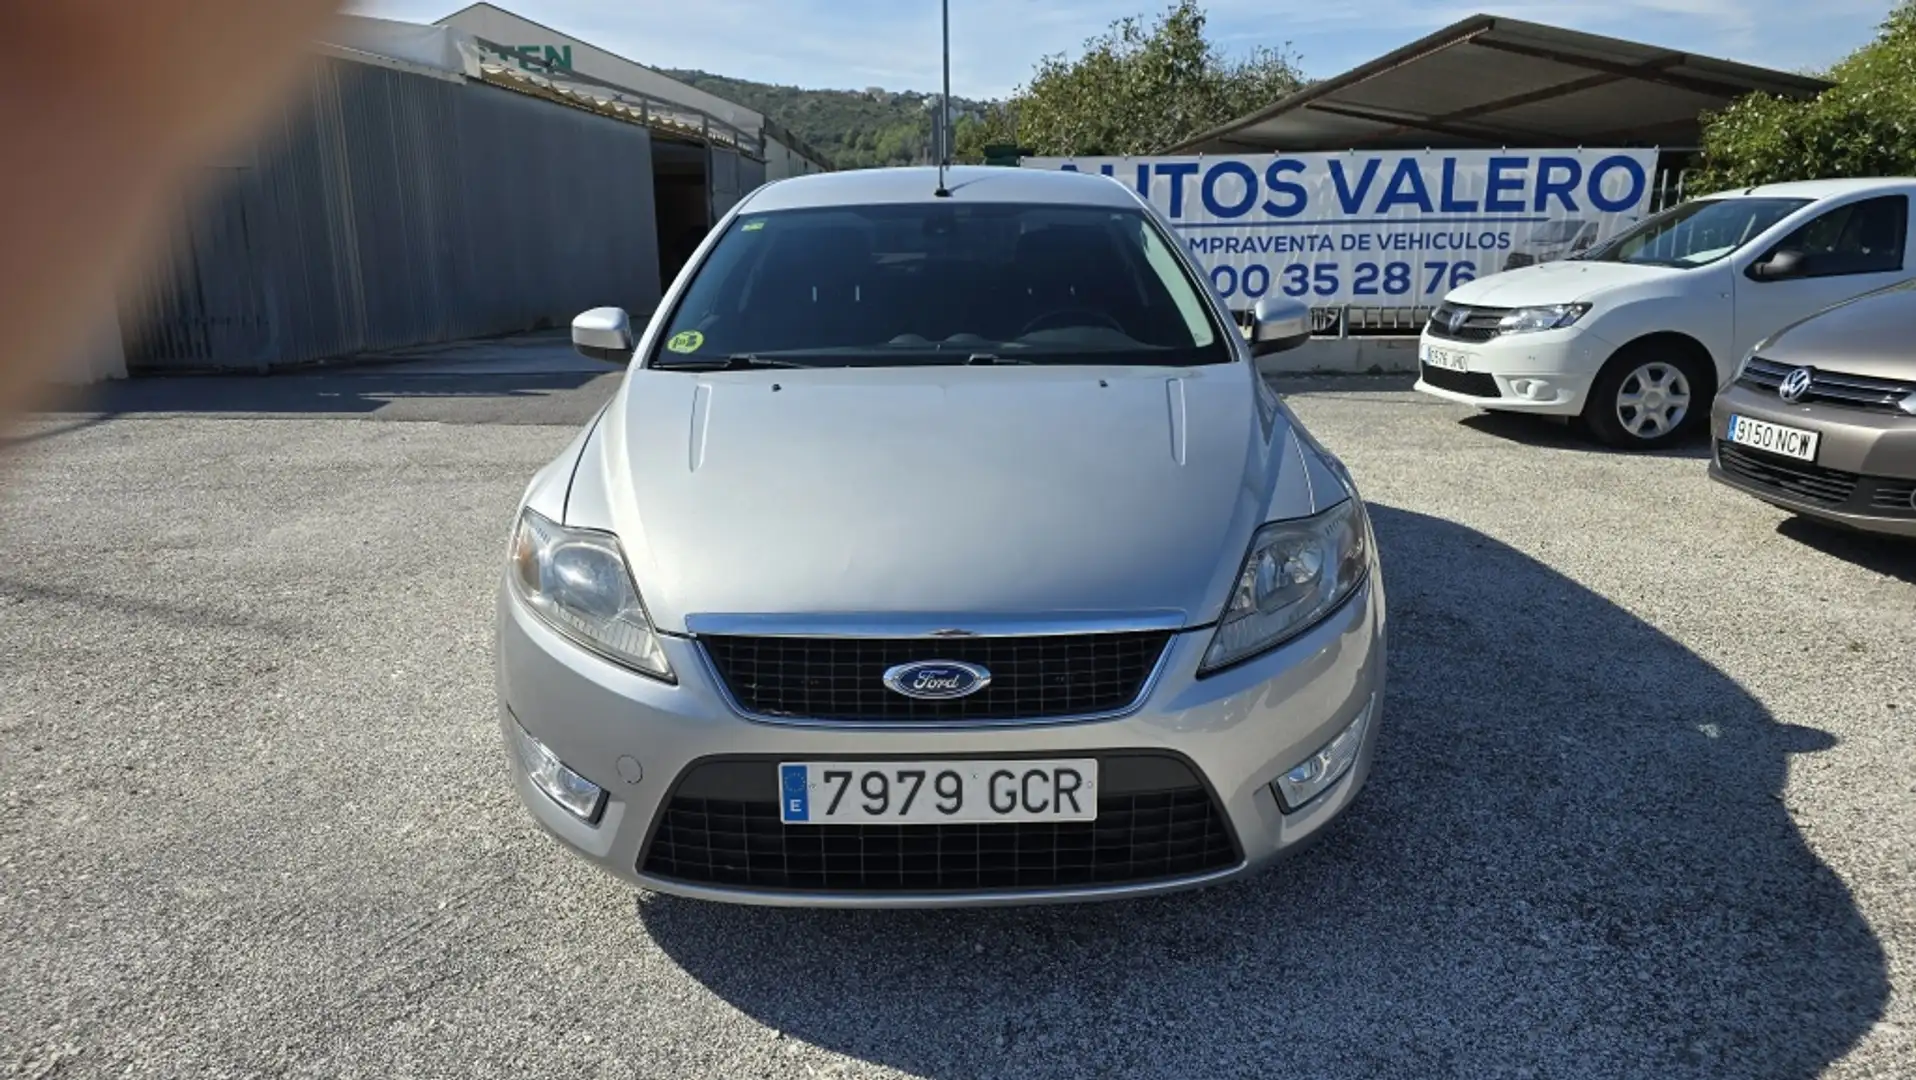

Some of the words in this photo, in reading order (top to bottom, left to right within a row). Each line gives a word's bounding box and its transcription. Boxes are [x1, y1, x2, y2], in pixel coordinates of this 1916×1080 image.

[1061, 159, 1308, 219] TOS
[1327, 155, 1646, 214] VALERO
[1189, 234, 1333, 254] MPRAVENTA
[1341, 233, 1371, 251] DE
[1377, 231, 1511, 250] VEHICULOS
[1210, 264, 1270, 299] 00
[1282, 263, 1340, 297] 35
[1353, 261, 1411, 295] 28
[1424, 260, 1476, 294] 76
[1736, 420, 1774, 448] 9150
[1775, 428, 1811, 457] NCW
[913, 669, 961, 690] Ford
[790, 799, 803, 812] E
[823, 769, 964, 816] 7979
[988, 768, 1083, 814] GCR
